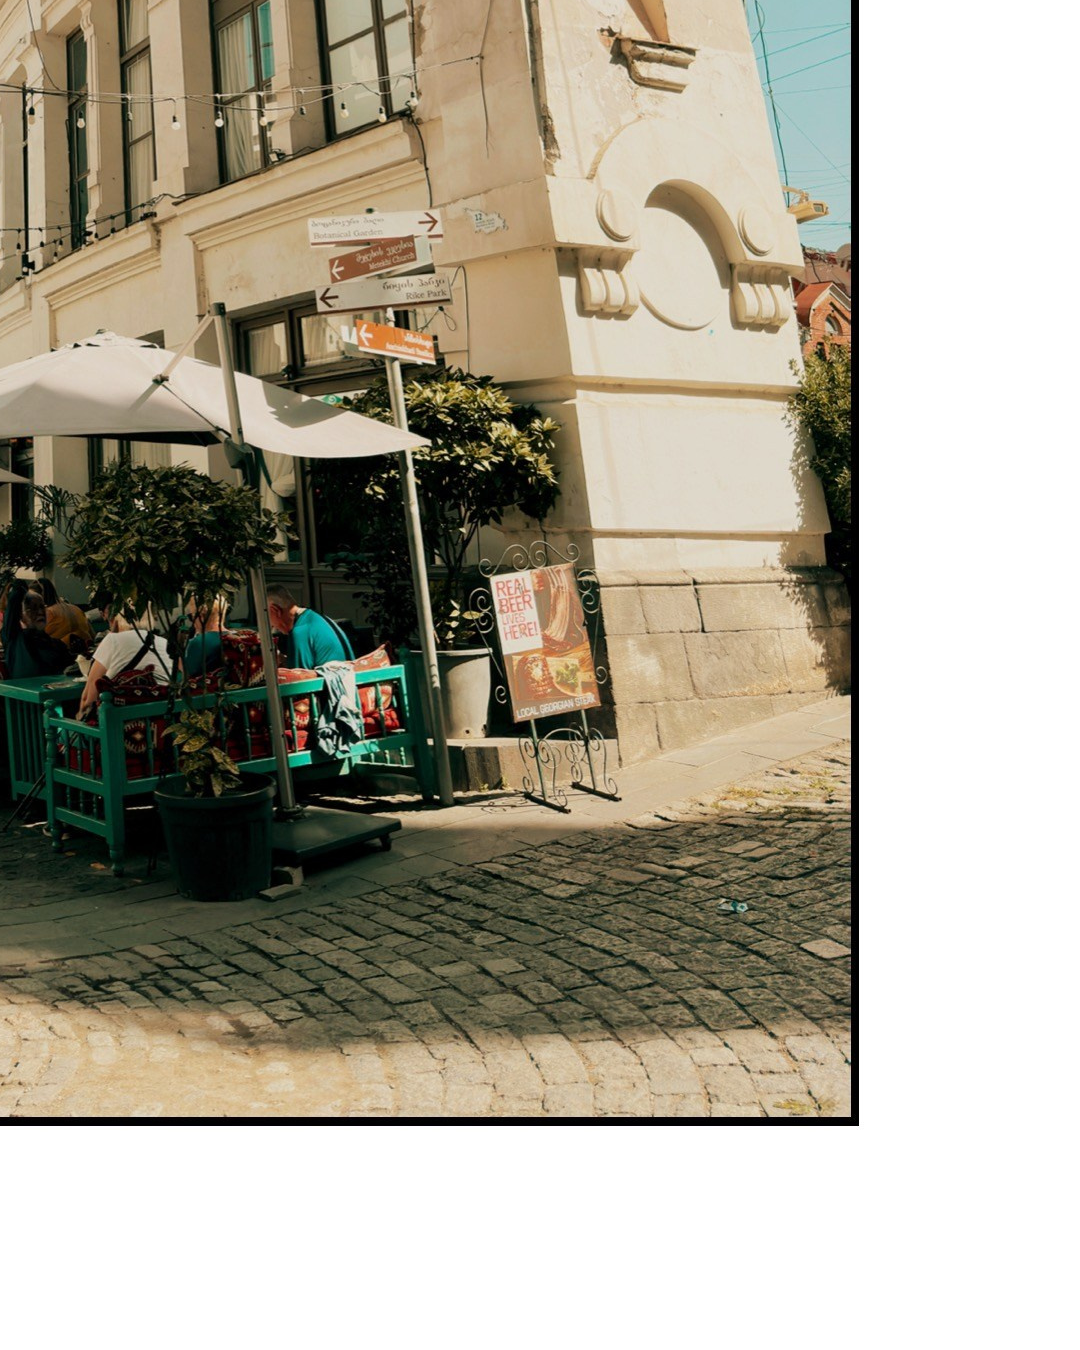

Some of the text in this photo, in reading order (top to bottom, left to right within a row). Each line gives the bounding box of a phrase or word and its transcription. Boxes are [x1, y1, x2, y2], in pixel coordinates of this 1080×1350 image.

[313, 229, 384, 240] Botanical Garden
[391, 251, 416, 263] Church
[405, 289, 447, 300] Rike Park
[495, 577, 531, 597] REAL
[498, 593, 534, 614] BEER
[501, 611, 526, 626] LIVES
[503, 621, 539, 641] HERE!
[516, 706, 540, 719] LOCAL
[540, 698, 574, 714] GEORGIAN
